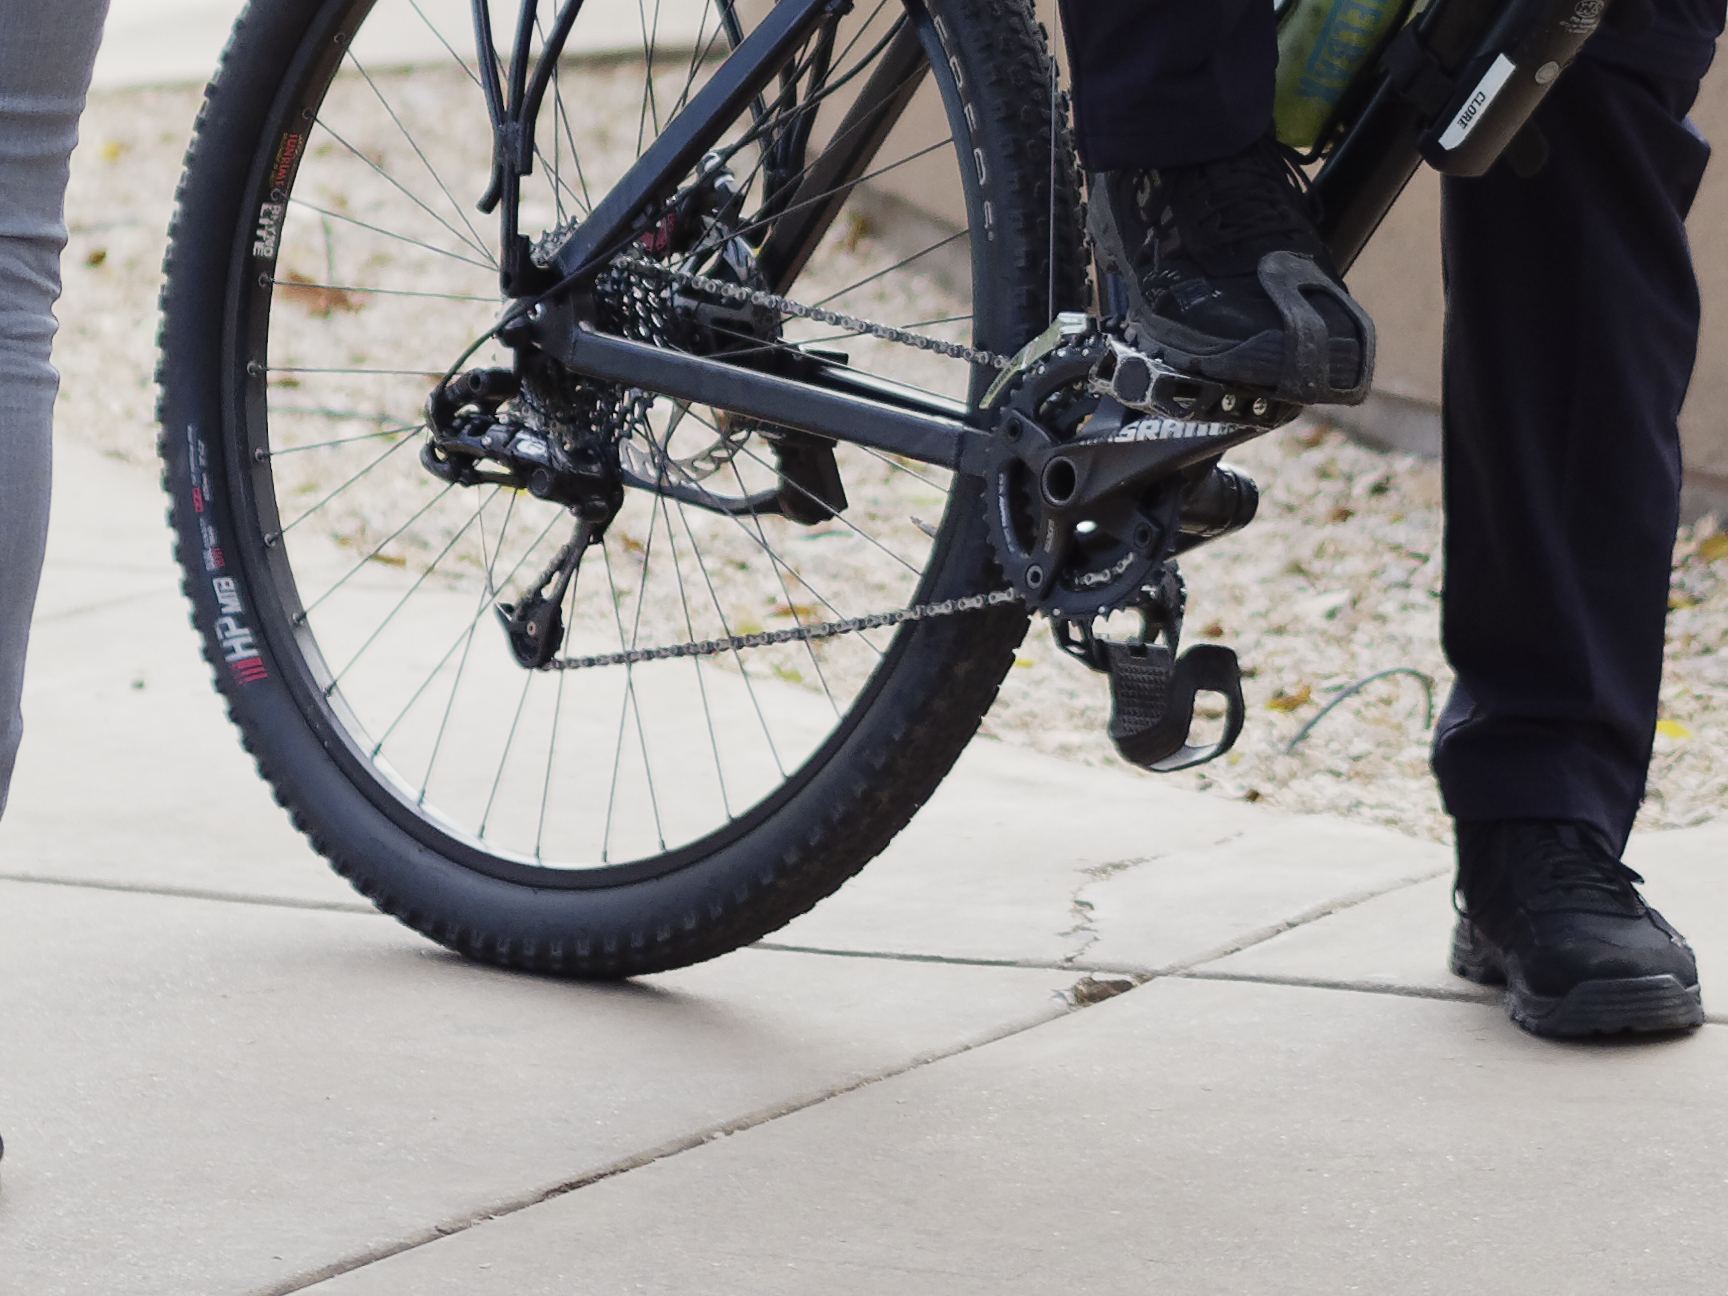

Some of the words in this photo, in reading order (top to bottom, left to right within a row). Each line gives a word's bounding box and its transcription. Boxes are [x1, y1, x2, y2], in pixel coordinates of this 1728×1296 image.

[1456, 90, 1487, 130] CLORE
[212, 575, 243, 614] MTB
[213, 616, 259, 663] HP
